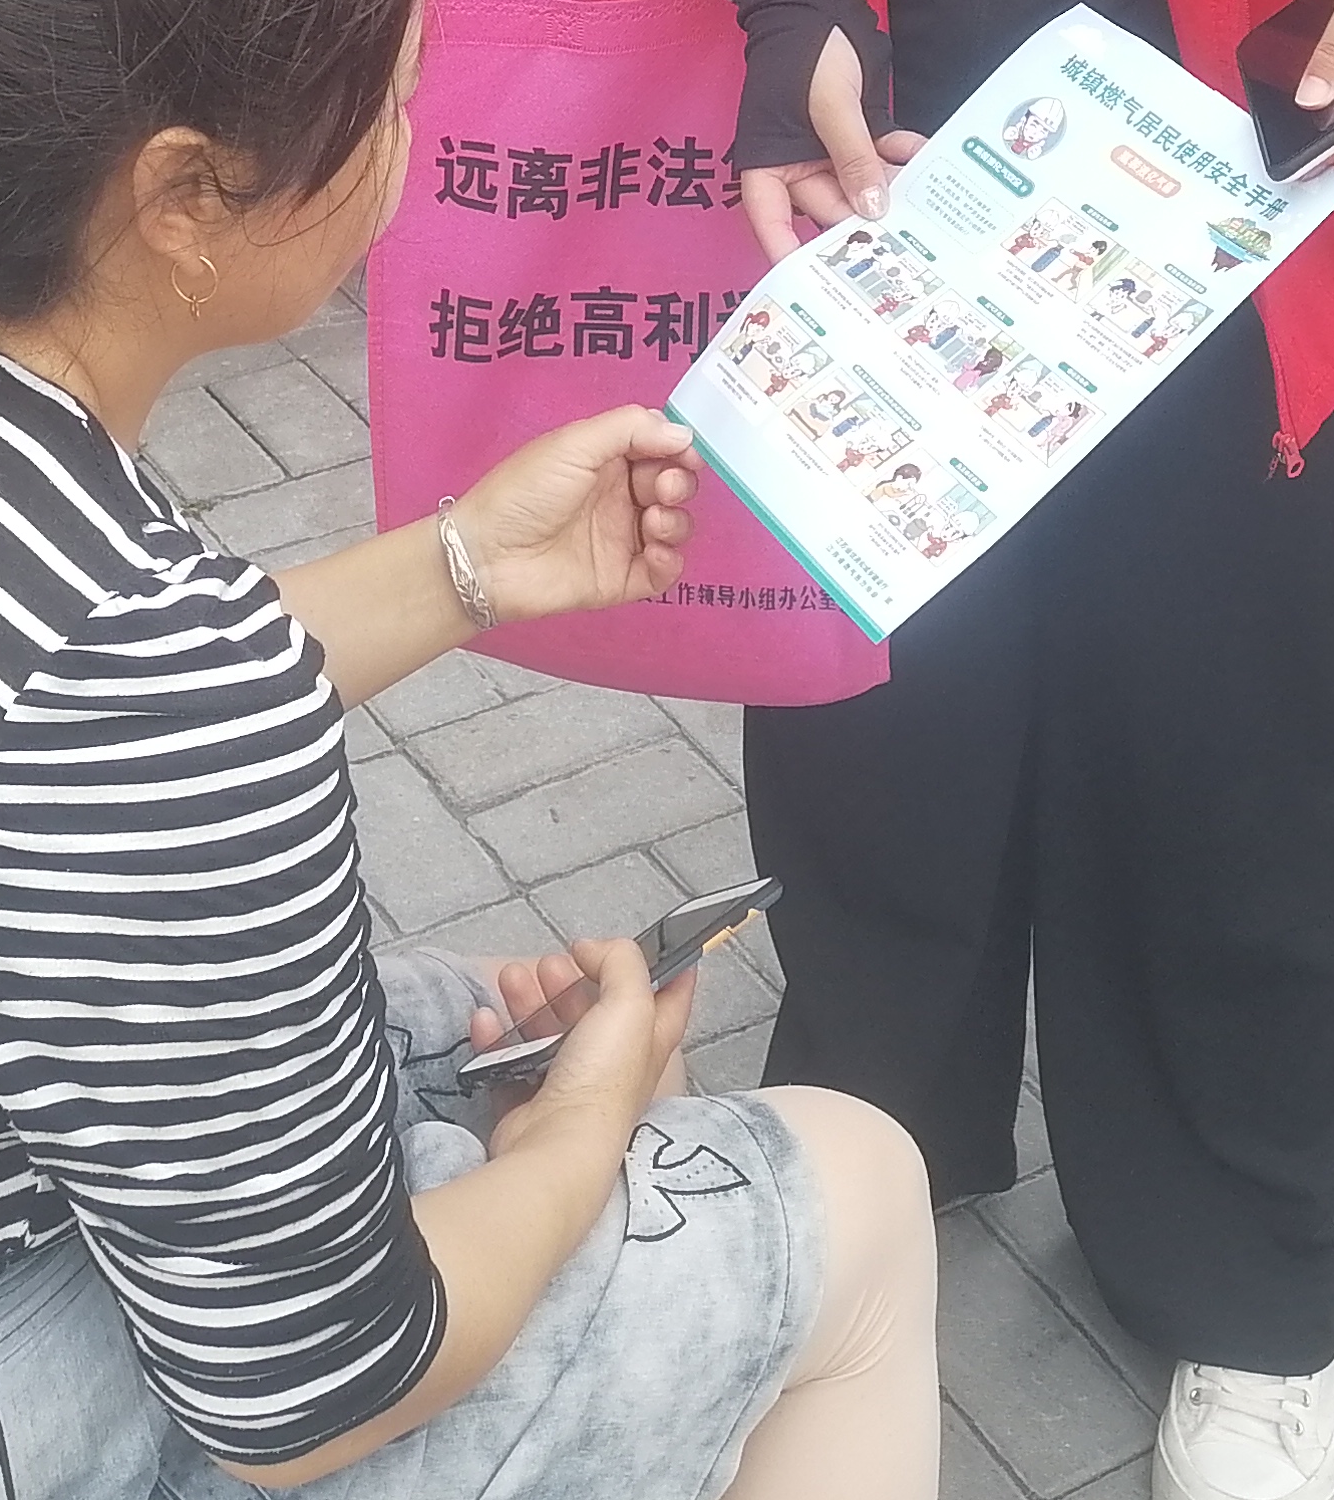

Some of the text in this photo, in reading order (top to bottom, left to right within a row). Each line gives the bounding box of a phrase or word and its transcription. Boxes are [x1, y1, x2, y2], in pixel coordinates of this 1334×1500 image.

[1060, 53, 1290, 221] 城镇燃气居民使用安全手册
[429, 285, 754, 364] 拒绝高利
[637, 581, 837, 611] 工作领导小组办公室
